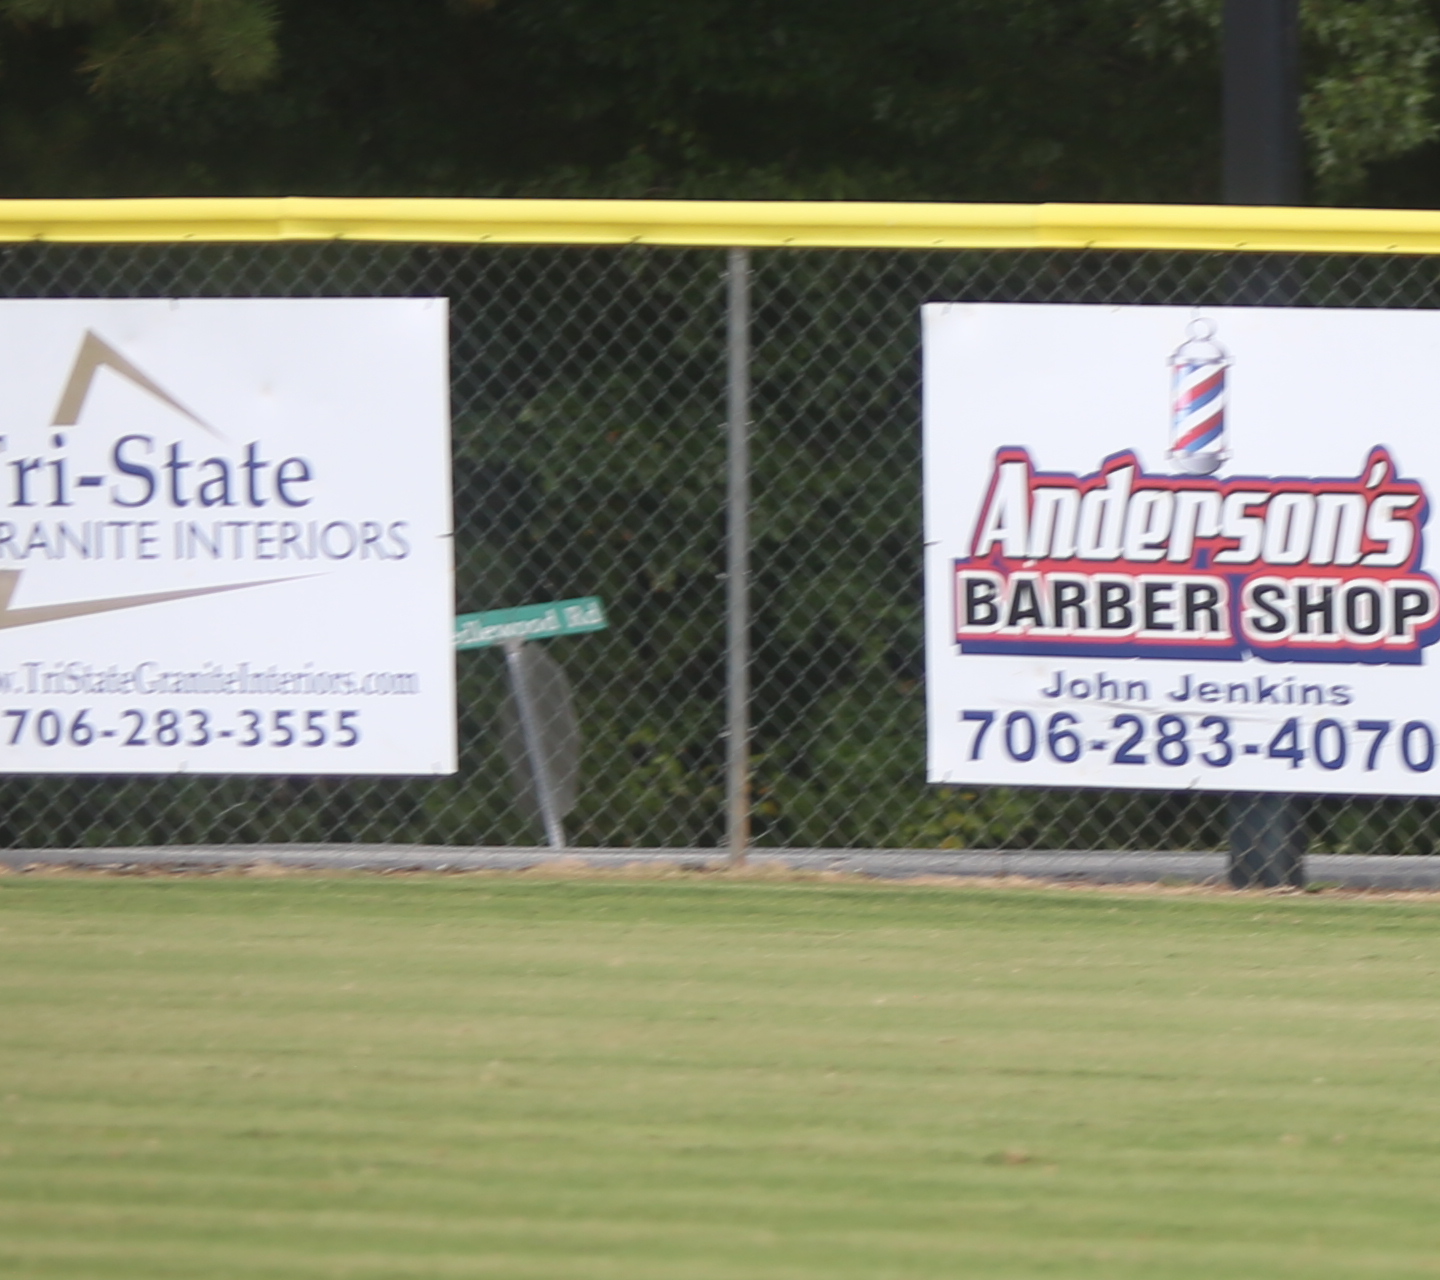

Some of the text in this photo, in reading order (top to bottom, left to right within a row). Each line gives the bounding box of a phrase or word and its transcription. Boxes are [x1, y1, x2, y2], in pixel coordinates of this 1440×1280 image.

[974, 458, 1422, 568] Anderson's
[173, 519, 410, 562] INTERIORS
[962, 572, 1434, 642] BARBER SHOP
[1040, 669, 1354, 707] John Jenkins
[2, 708, 362, 748] 706-283-3555
[961, 709, 1437, 773] 706-283-4070
